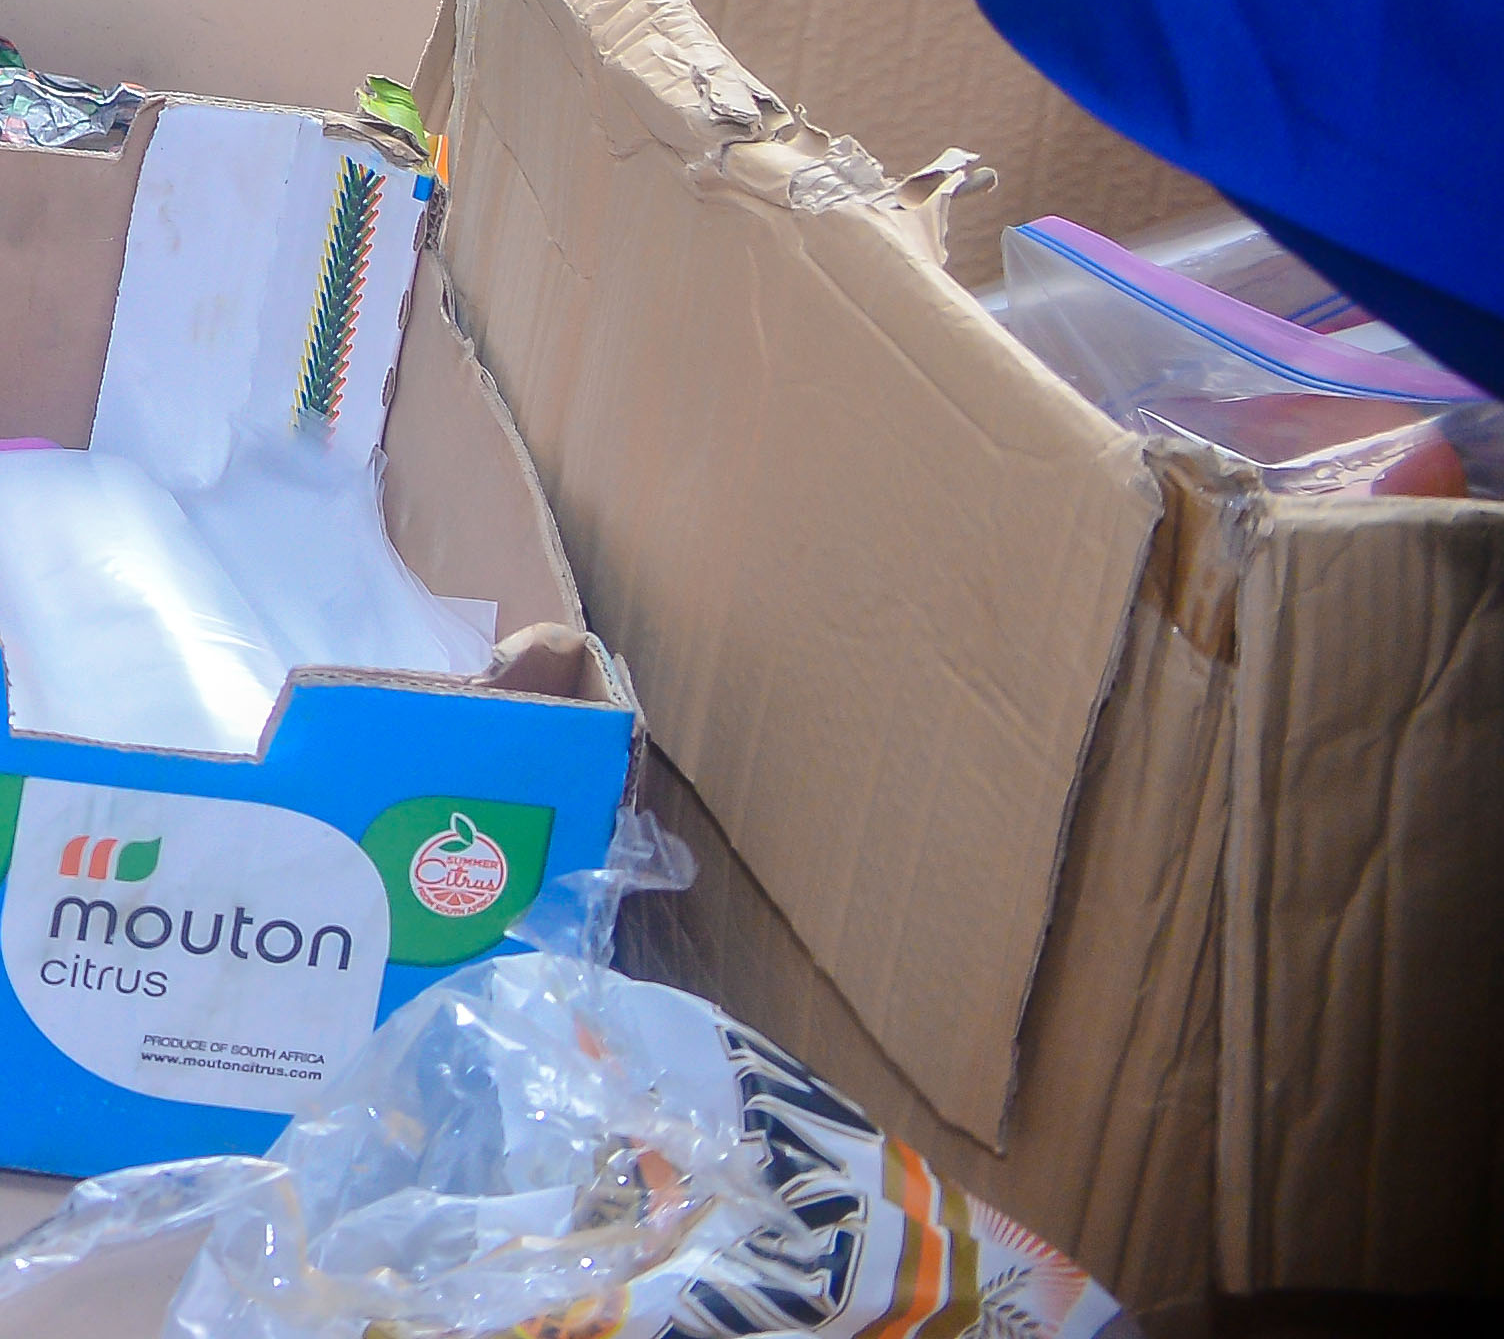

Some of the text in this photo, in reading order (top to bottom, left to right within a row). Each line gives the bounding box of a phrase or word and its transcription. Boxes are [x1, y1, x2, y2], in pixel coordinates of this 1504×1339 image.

[415, 858, 498, 892] Citrus
[447, 856, 498, 869] SUMMER
[49, 895, 353, 971] mouton
[40, 953, 169, 998] citrus
[140, 1050, 322, 1081] www.moutoncitrus.com
[143, 1034, 325, 1065] PRODUCE OF SOUTH AFRICA
